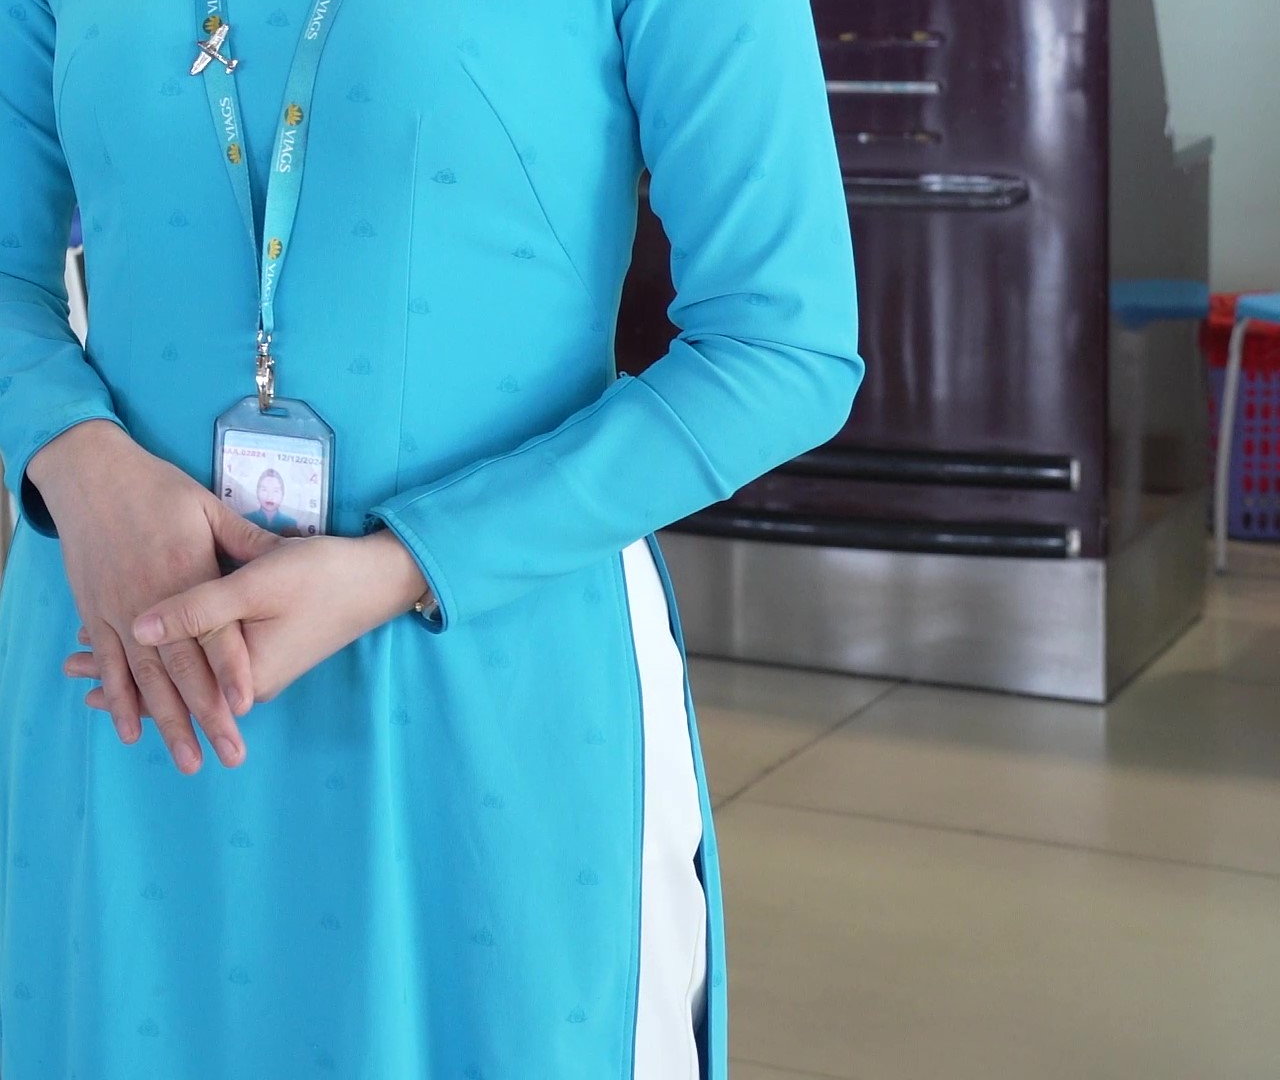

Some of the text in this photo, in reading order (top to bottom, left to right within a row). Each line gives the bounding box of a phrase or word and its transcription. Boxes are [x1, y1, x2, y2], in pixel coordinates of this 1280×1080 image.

[307, 0, 330, 40] VIAGS
[220, 97, 236, 141] VIAGS
[279, 129, 297, 174] VIAGS
[224, 488, 232, 498] 2
[308, 524, 316, 534] 6
